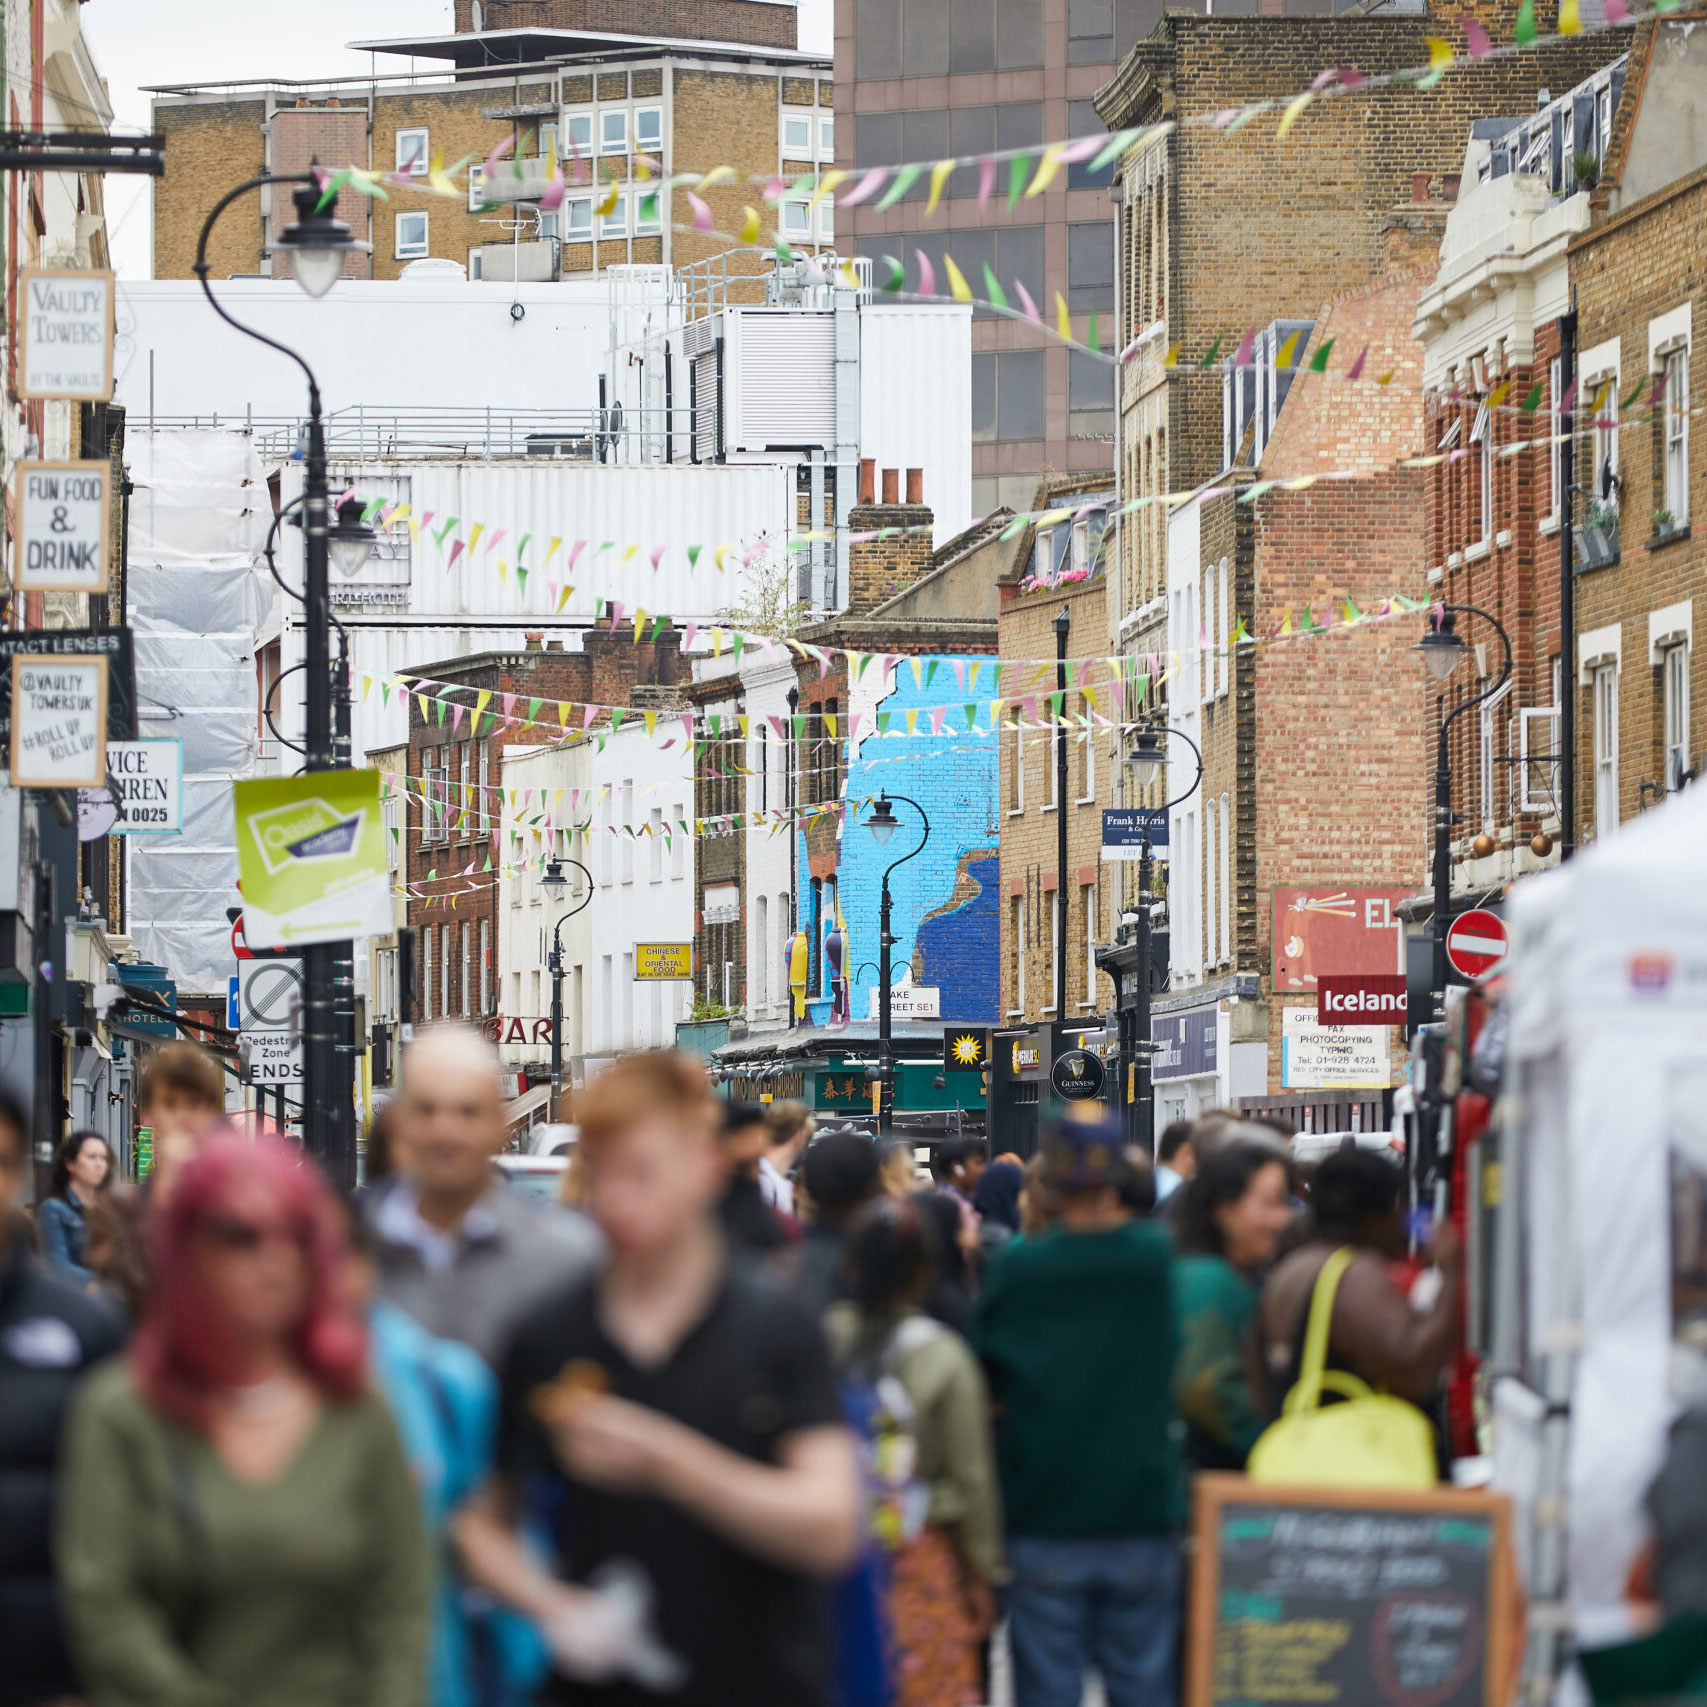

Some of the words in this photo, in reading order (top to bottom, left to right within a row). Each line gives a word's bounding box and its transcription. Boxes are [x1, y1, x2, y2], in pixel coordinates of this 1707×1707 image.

[32, 282, 101, 313] VAULTY
[32, 315, 102, 344] TOWERS
[64, 478, 102, 501] FOOD
[51, 506, 76, 532] &
[27, 540, 98, 571] DRINK
[53, 635, 120, 653] LENSES
[20, 672, 82, 691] @VAULTY
[64, 718, 80, 737] UP
[48, 741, 80, 762] ROLL
[79, 734, 95, 751] UP
[131, 807, 168, 822] 0025
[1107, 815, 1134, 825] Frank
[653, 966, 676, 974] FOOD
[917, 1003, 933, 1011] SE1
[482, 1017, 553, 1045] BAR
[1327, 1025, 1345, 1033] FAX
[1300, 1035, 1373, 1044] PHOTOCOPYING
[262, 1048, 291, 1058] Zone
[1320, 1046, 1353, 1055] TYPING
[1298, 1057, 1313, 1065] Tel:
[1316, 1056, 1350, 1065] 01-928
[1354, 1056, 1376, 1065] 4724
[251, 1063, 305, 1078] ENDS
